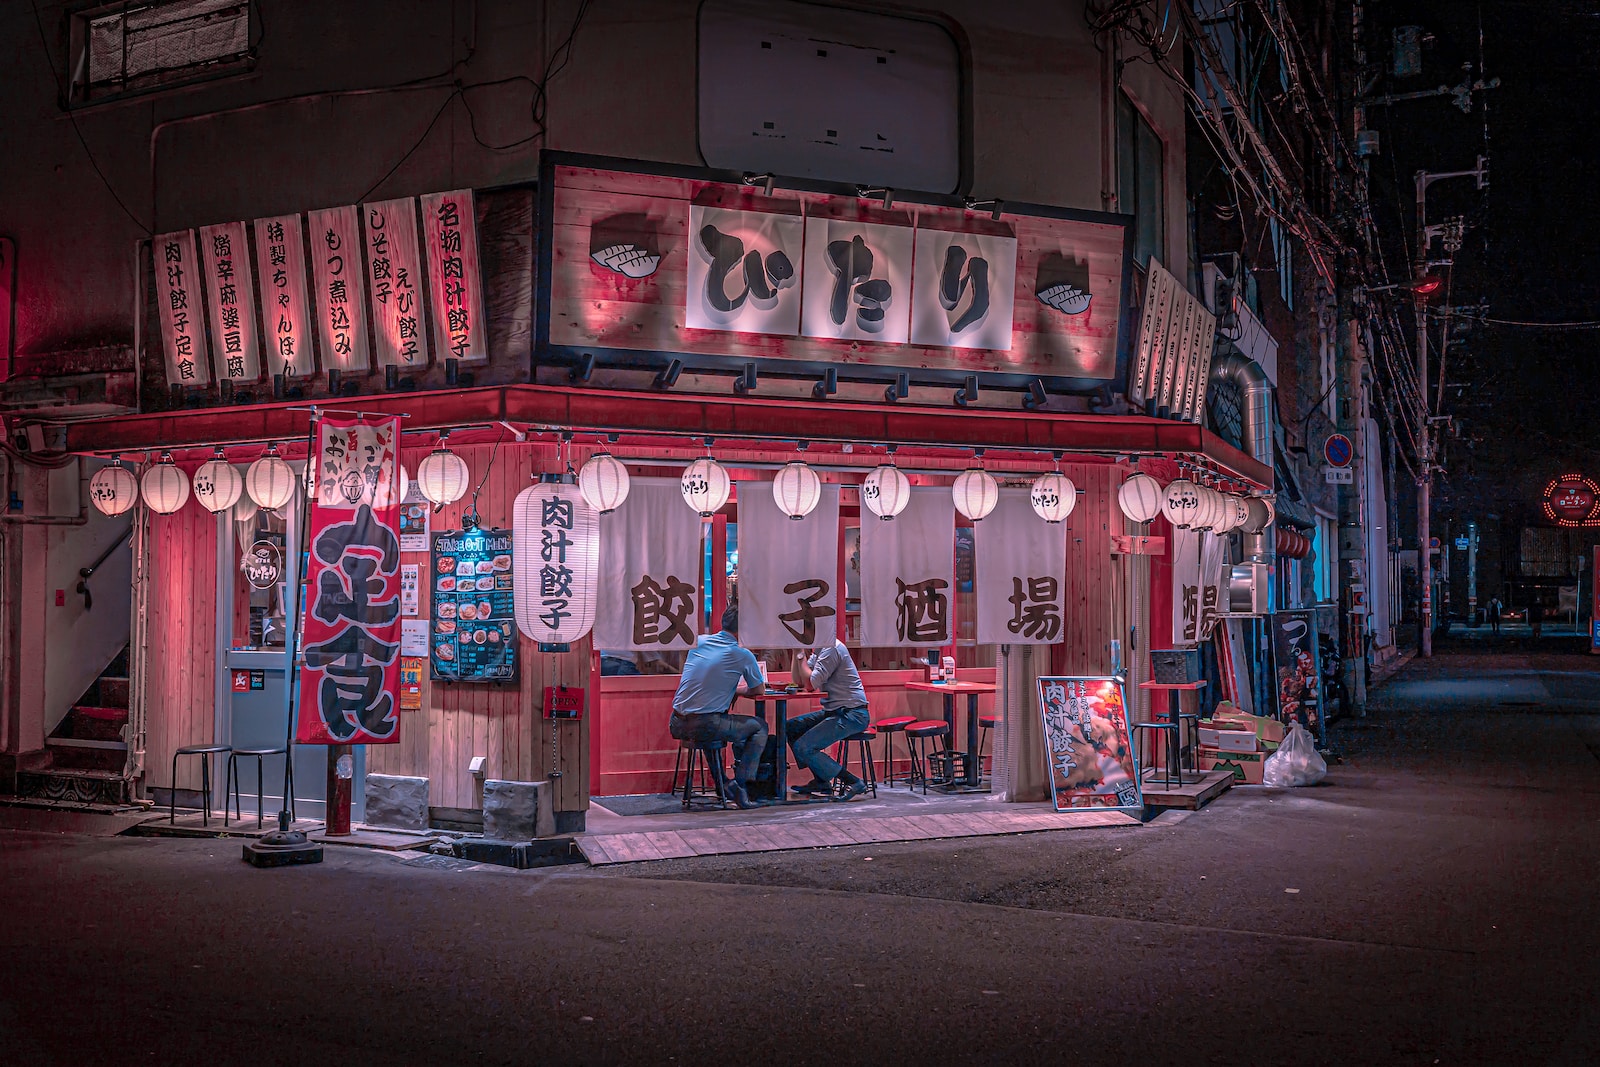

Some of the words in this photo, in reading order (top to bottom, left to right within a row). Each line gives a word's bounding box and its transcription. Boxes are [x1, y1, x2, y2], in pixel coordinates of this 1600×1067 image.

[165, 241, 195, 380] 肉汁餃子定食
[214, 234, 244, 378] 激辛麻婆豆腐
[267, 221, 297, 377] 特製ちゃんぽん
[325, 228, 352, 355] もつ煮込み
[370, 209, 393, 304] しそ餃子
[396, 267, 419, 362] えび餃子
[438, 202, 471, 358] 名物肉汁餃子
[304, 503, 400, 739] 定食
[539, 495, 574, 630] 肉汁餃子
[551, 697, 578, 706] OPEN
[1044, 681, 1077, 778] 肉汁餃子
